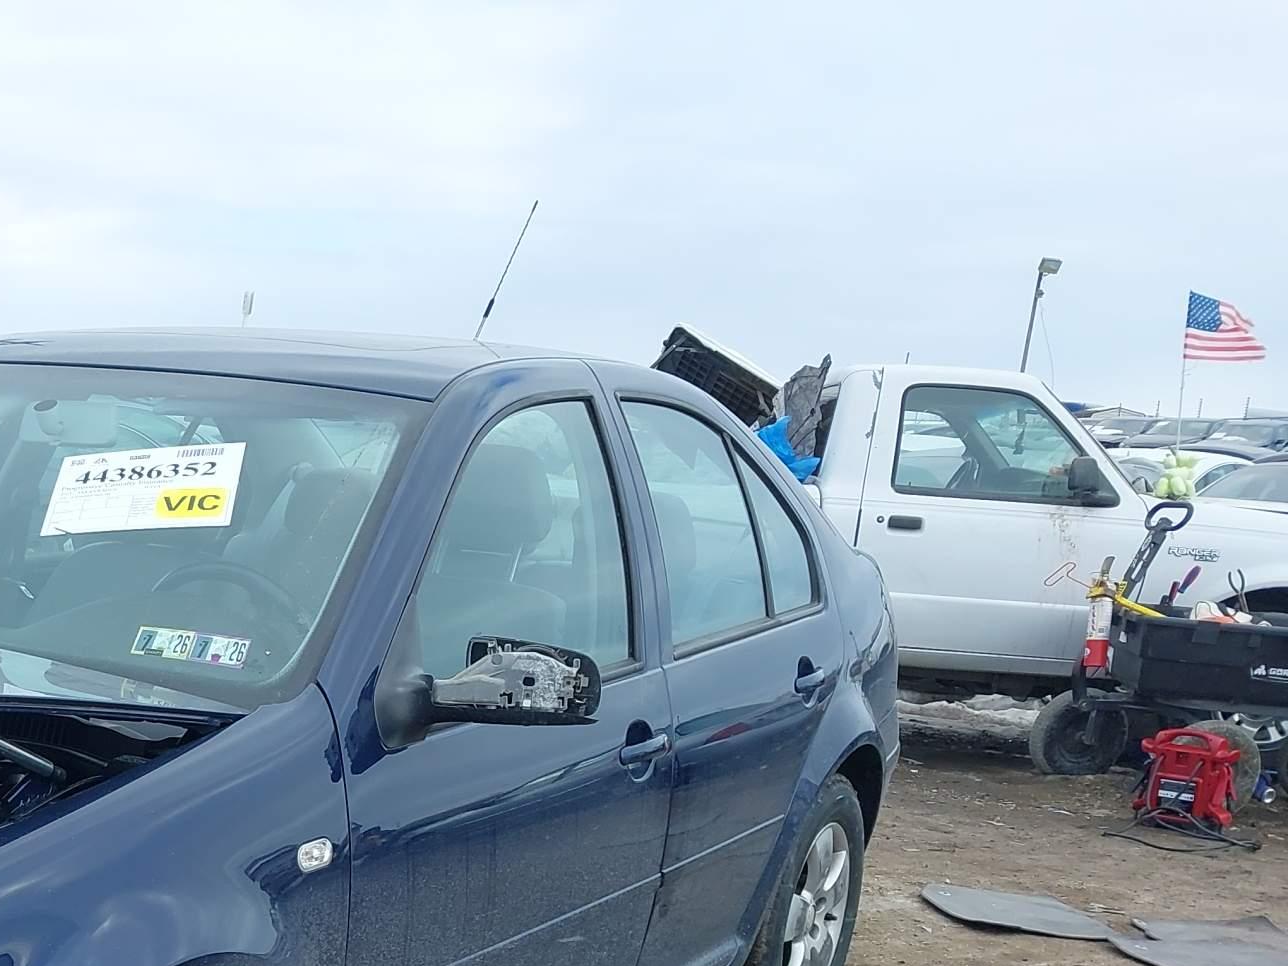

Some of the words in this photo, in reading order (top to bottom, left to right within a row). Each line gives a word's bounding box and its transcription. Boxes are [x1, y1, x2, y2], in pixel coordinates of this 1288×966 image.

[75, 462, 217, 484] 44386352
[163, 494, 221, 511] VIC
[142, 634, 154, 651] 7
[172, 634, 191, 654] 26
[197, 640, 209, 658] 7
[228, 641, 247, 662] 26
